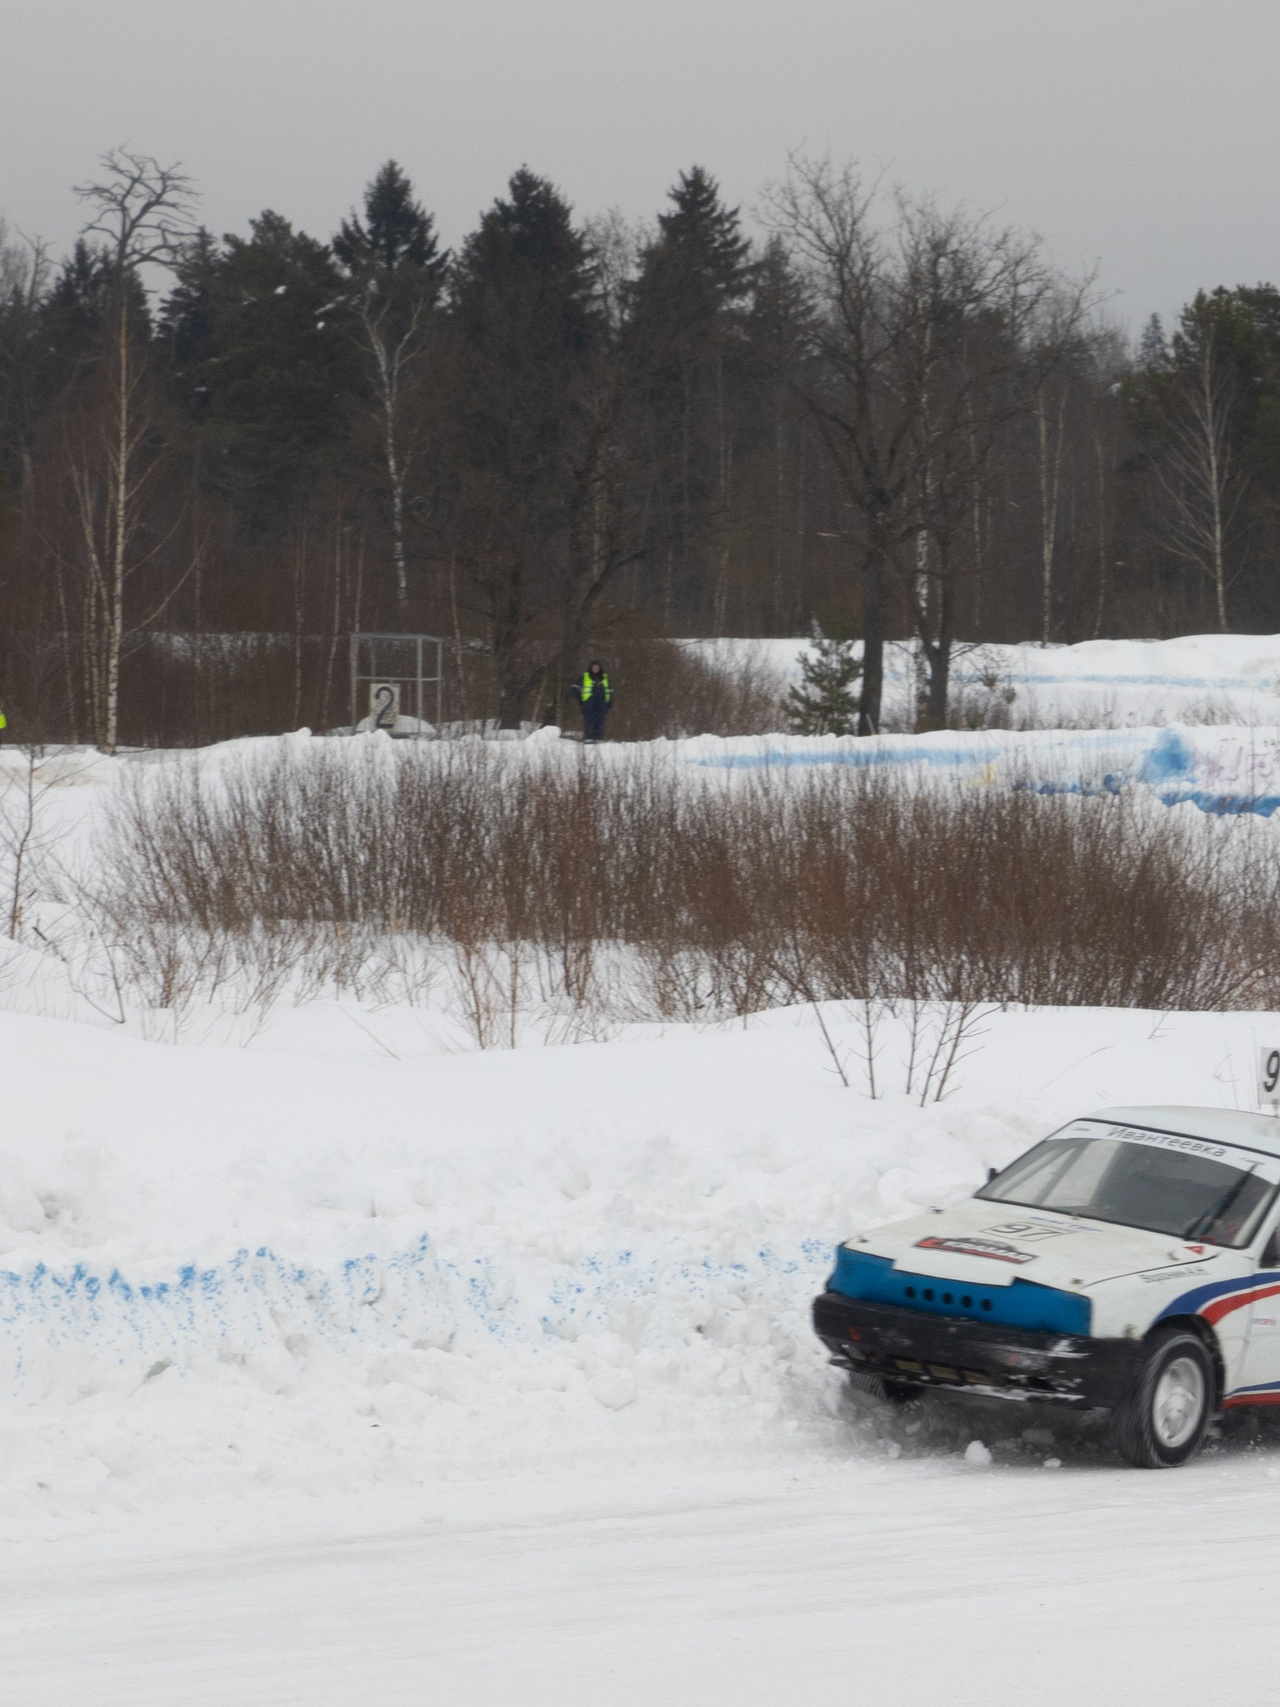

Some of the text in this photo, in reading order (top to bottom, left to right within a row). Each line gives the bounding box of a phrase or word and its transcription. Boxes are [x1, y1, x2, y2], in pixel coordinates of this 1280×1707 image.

[374, 686, 395, 729] 2
[1106, 1126, 1227, 1158] Ивантеевка
[992, 1223, 1062, 1238] 97
